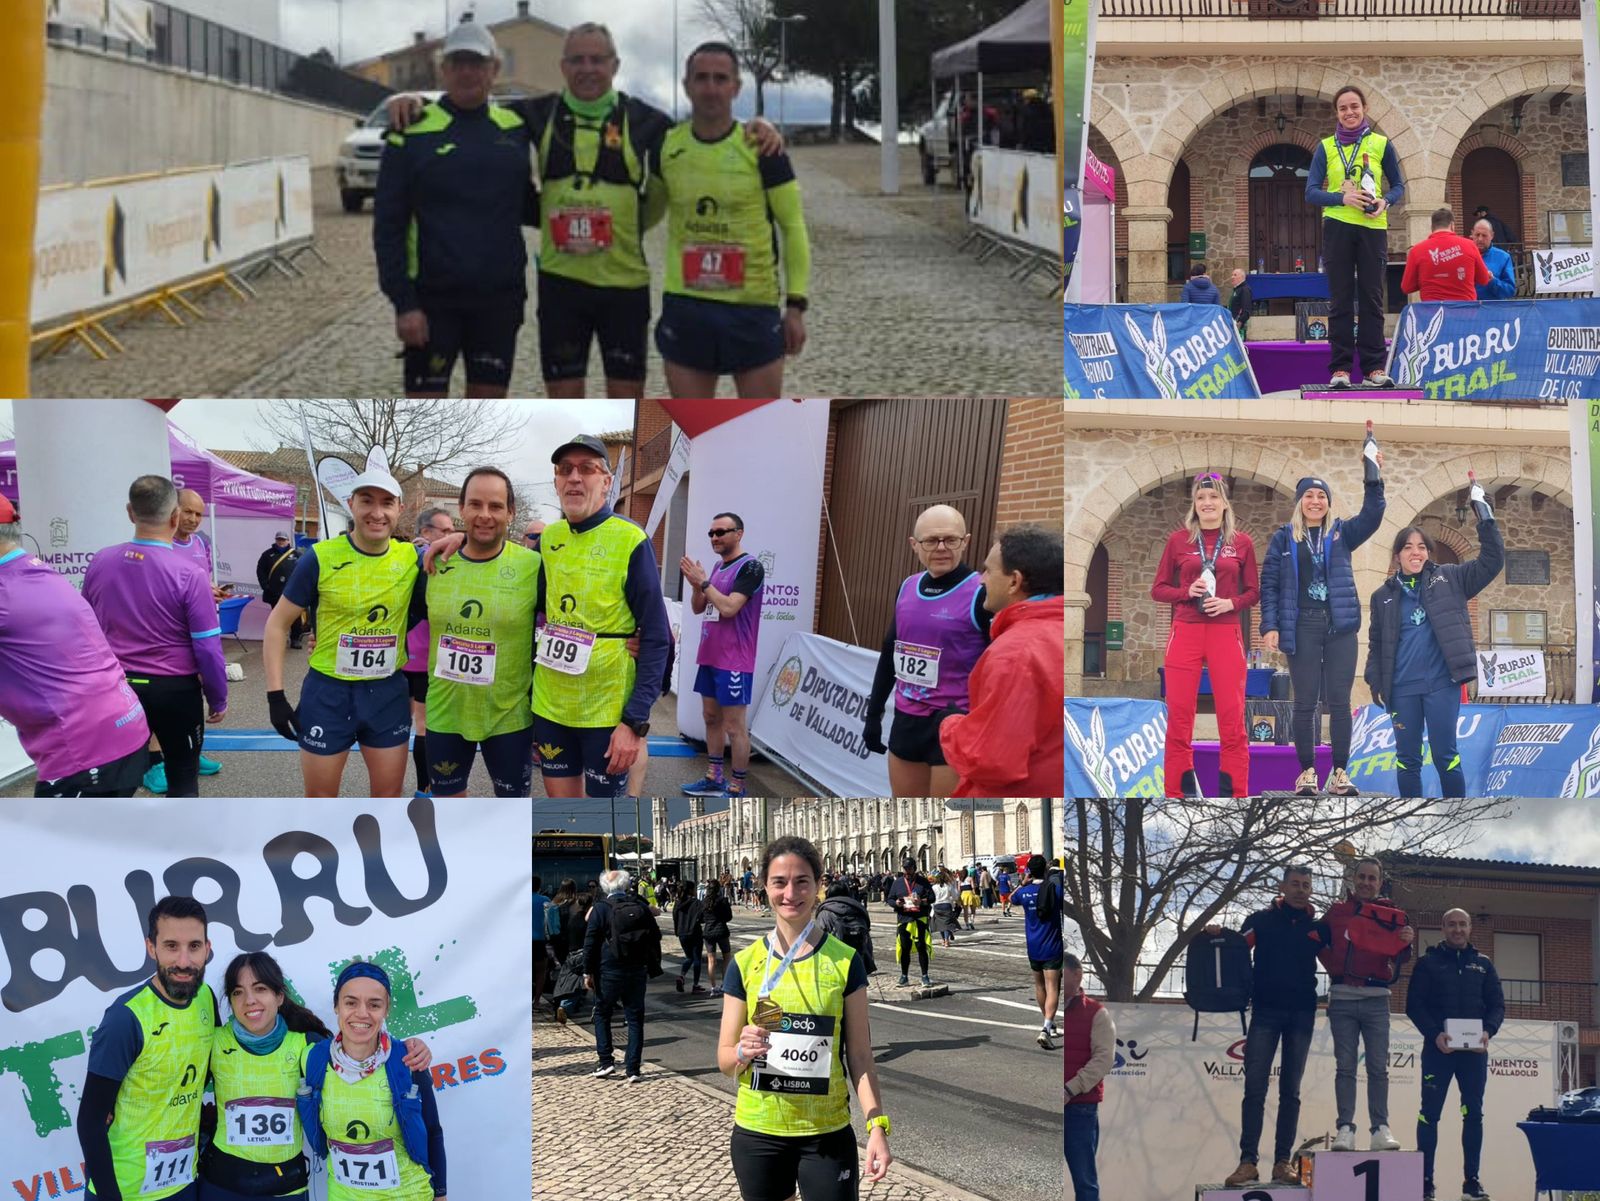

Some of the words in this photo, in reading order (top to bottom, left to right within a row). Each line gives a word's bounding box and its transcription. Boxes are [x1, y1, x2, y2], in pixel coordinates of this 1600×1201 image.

[568, 217, 592, 238] 48
[702, 252, 723, 273] 47
[1554, 251, 1591, 272] BURRU
[1555, 264, 1594, 281] TRAIL
[1170, 314, 1232, 380] BURRU
[1433, 317, 1521, 375] BURRU
[1184, 352, 1247, 399] TRAIL
[1424, 359, 1518, 399] TRAIL
[445, 622, 491, 637] Adarsa
[350, 649, 386, 668] 164
[546, 638, 578, 663] 199
[448, 651, 483, 675] 103
[900, 655, 928, 677] 182
[1497, 654, 1536, 675] BURRU
[1498, 668, 1539, 685] TRAIL
[789, 702, 805, 722] DE
[805, 704, 871, 760] VALLADOLID
[0, 798, 448, 1012] BURRU
[792, 1017, 816, 1033] edp
[780, 1048, 818, 1062] 4060
[1490, 1067, 1539, 1077] VALLADOLID
[783, 1079, 811, 1089] LISBOA
[235, 1112, 287, 1136] 136
[154, 1154, 189, 1182] 111
[338, 1158, 387, 1180] 171
[350, 1179, 380, 1187] CRISTINA
[1352, 1159, 1381, 1201] 1
